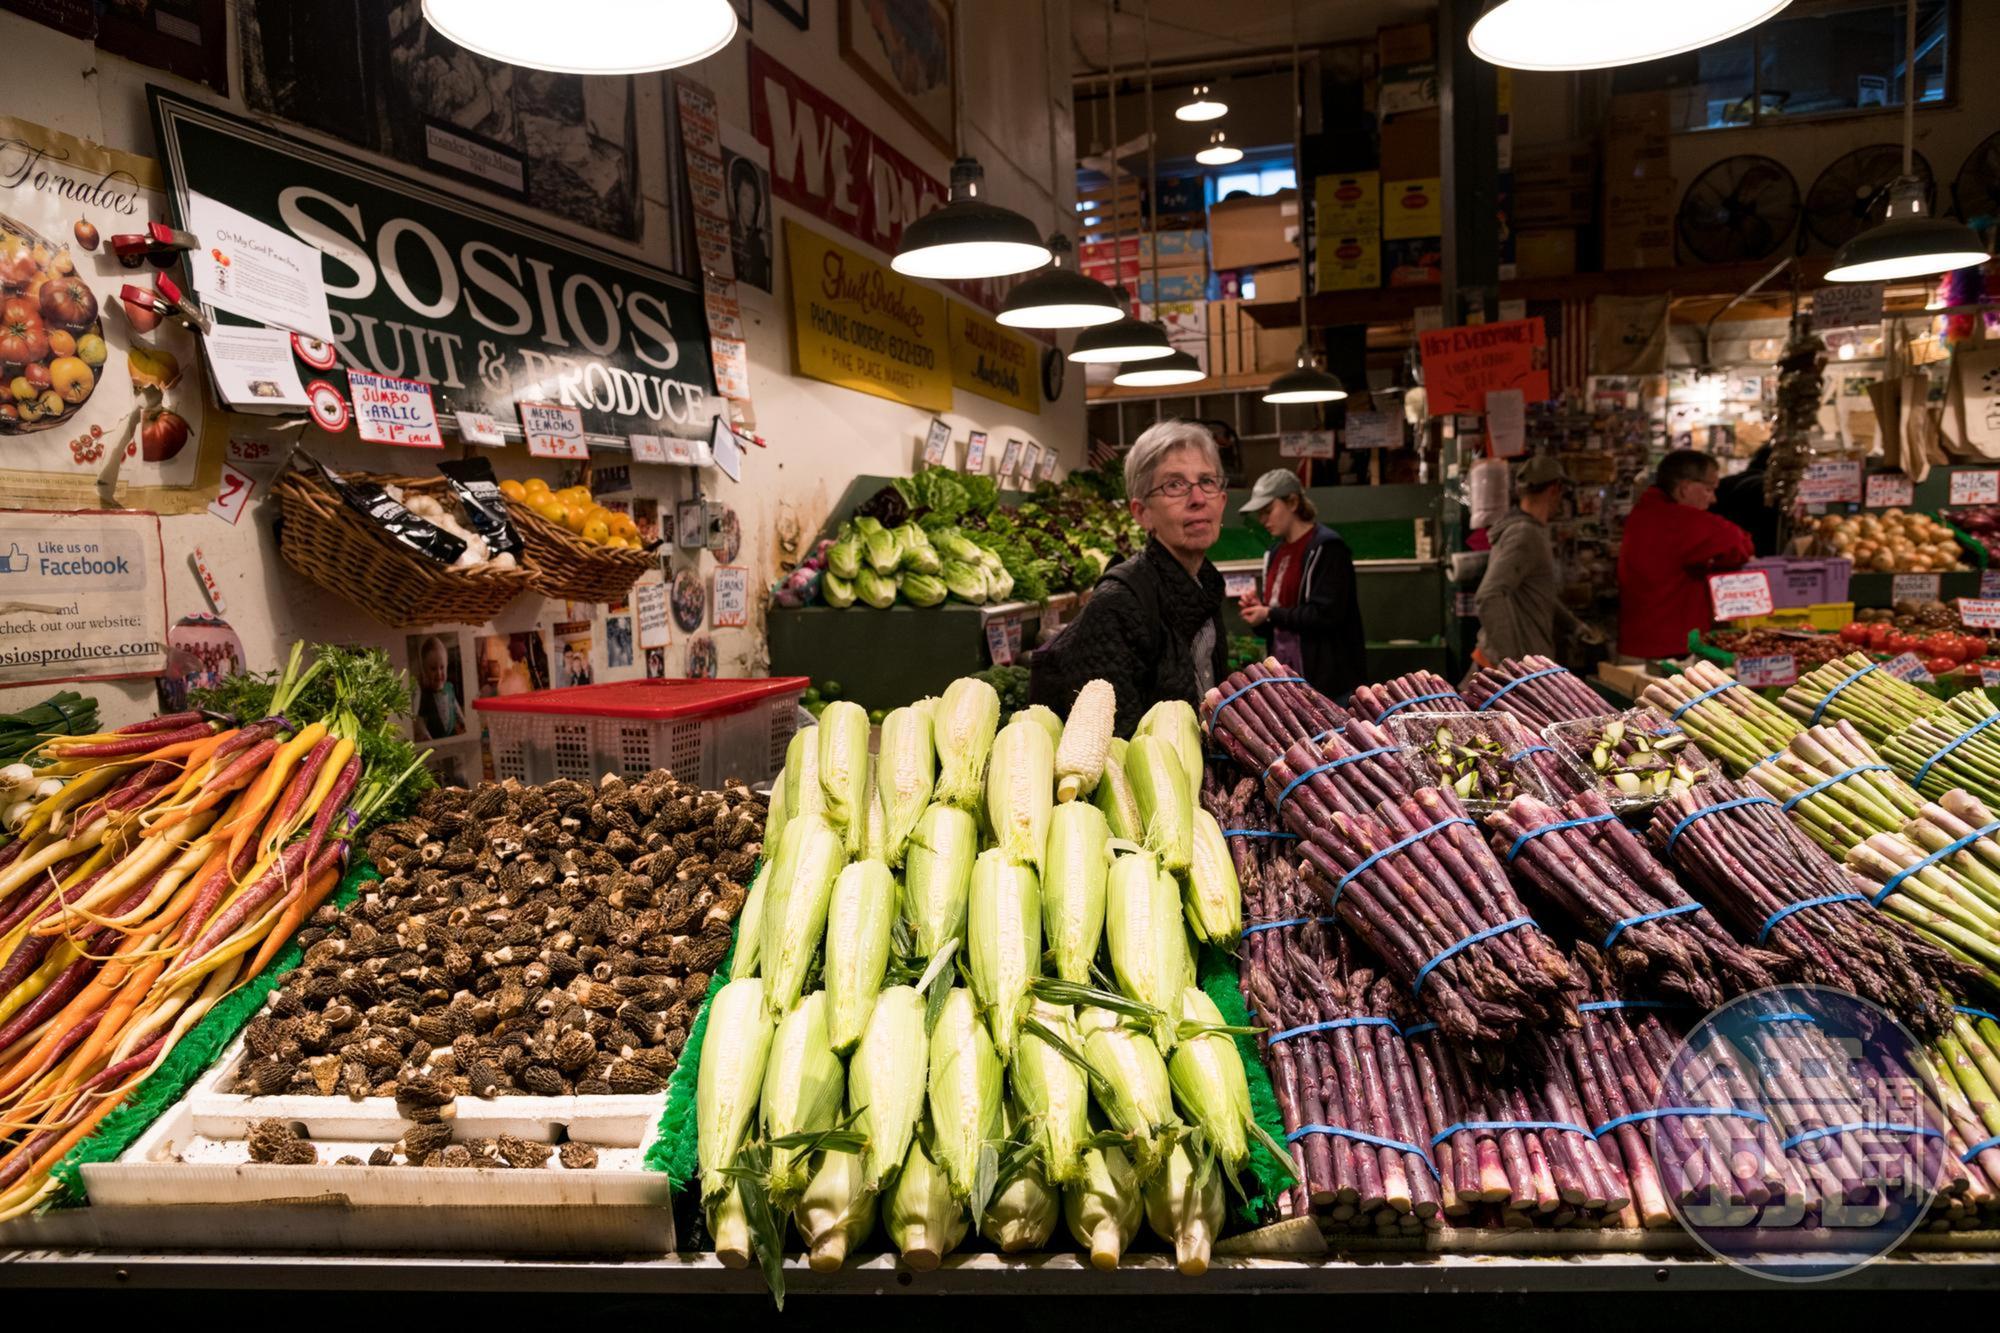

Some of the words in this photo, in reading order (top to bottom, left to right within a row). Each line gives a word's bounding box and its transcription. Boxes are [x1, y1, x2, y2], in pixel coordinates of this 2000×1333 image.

[764, 76, 858, 216] WE
[278, 186, 680, 370] SOSIO'S
[810, 301, 849, 342] PHONE
[328, 308, 467, 391] RUIT
[478, 339, 510, 394] &
[518, 348, 710, 427] PRODUCE
[832, 347, 853, 372] PIKE
[363, 387, 409, 405] JUMBO
[528, 418, 574, 433] LEMONS
[531, 408, 563, 421] MEYER
[38, 542, 63, 554] Like
[66, 545, 81, 554] us
[84, 544, 99, 554] on
[40, 556, 129, 576] Facebook
[0, 620, 36, 635] check
[40, 622, 62, 632] out
[65, 620, 86, 631] our
[88, 614, 141, 629] website:
[0, 641, 160, 667] siosproduce.com
